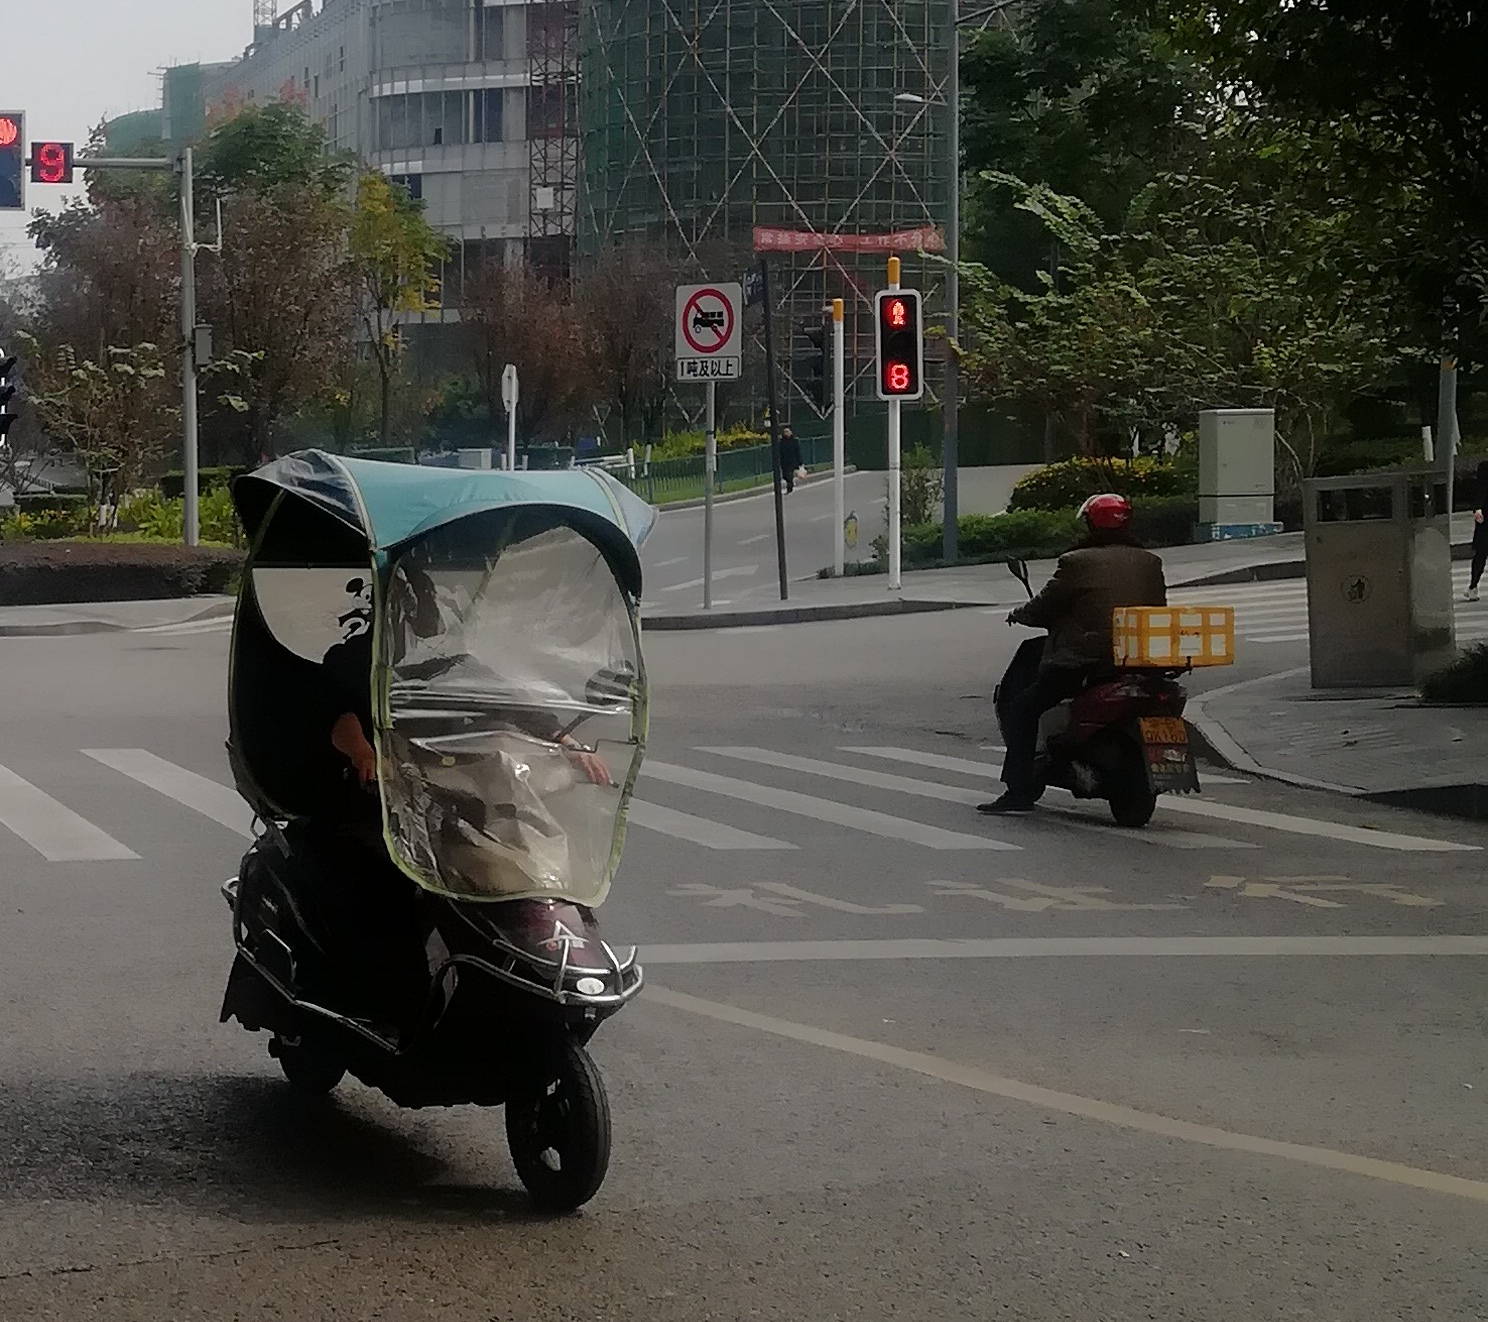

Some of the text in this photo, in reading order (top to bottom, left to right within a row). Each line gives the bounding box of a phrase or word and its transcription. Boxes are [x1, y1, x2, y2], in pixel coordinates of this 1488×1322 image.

[39, 143, 66, 182] 9
[680, 360, 734, 377] 1吨及以上
[891, 364, 909, 389] 8
